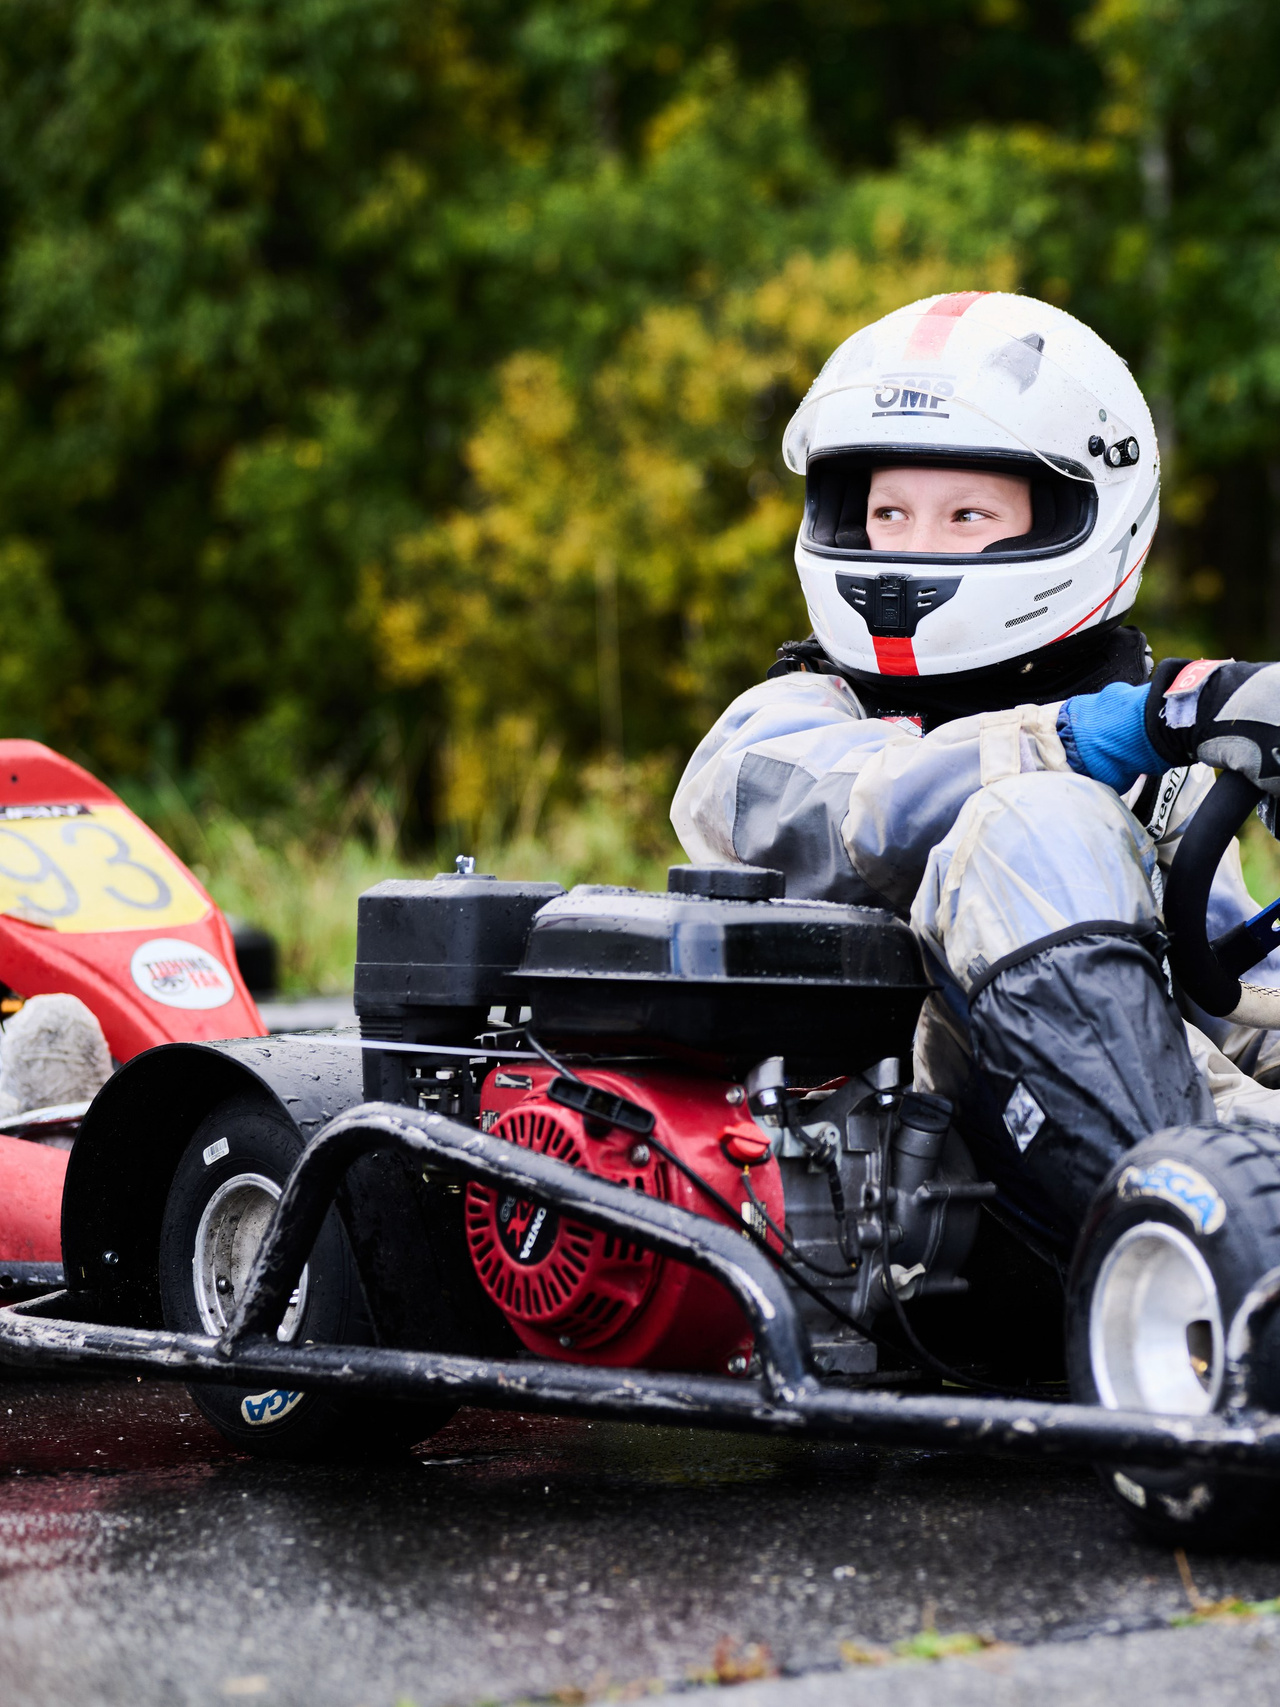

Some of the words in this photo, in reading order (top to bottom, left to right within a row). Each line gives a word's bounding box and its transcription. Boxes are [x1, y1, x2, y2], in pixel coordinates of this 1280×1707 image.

[873, 379, 955, 409] OMP
[0, 821, 172, 918] 93
[519, 1207, 548, 1260] ONDA
